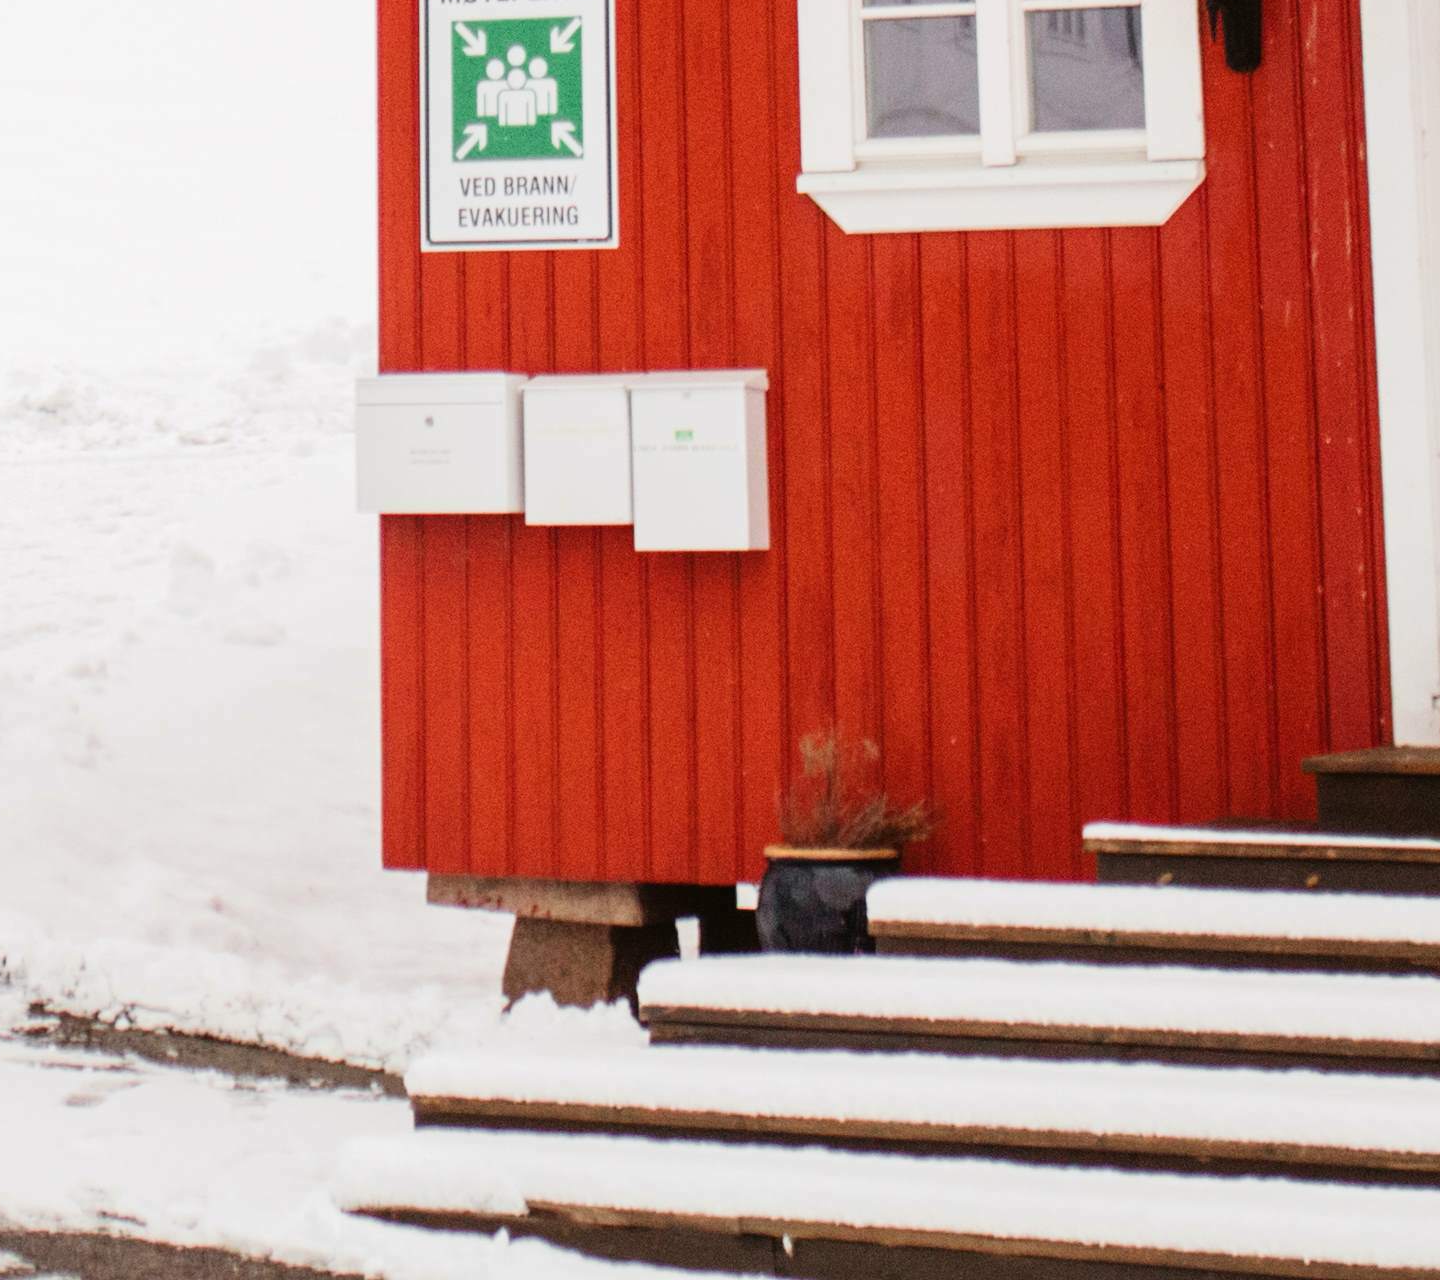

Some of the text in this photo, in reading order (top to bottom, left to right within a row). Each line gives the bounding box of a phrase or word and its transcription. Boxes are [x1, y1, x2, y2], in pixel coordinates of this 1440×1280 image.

[458, 174, 578, 198] VED BRANN/
[457, 204, 580, 228] EVAKUERING
